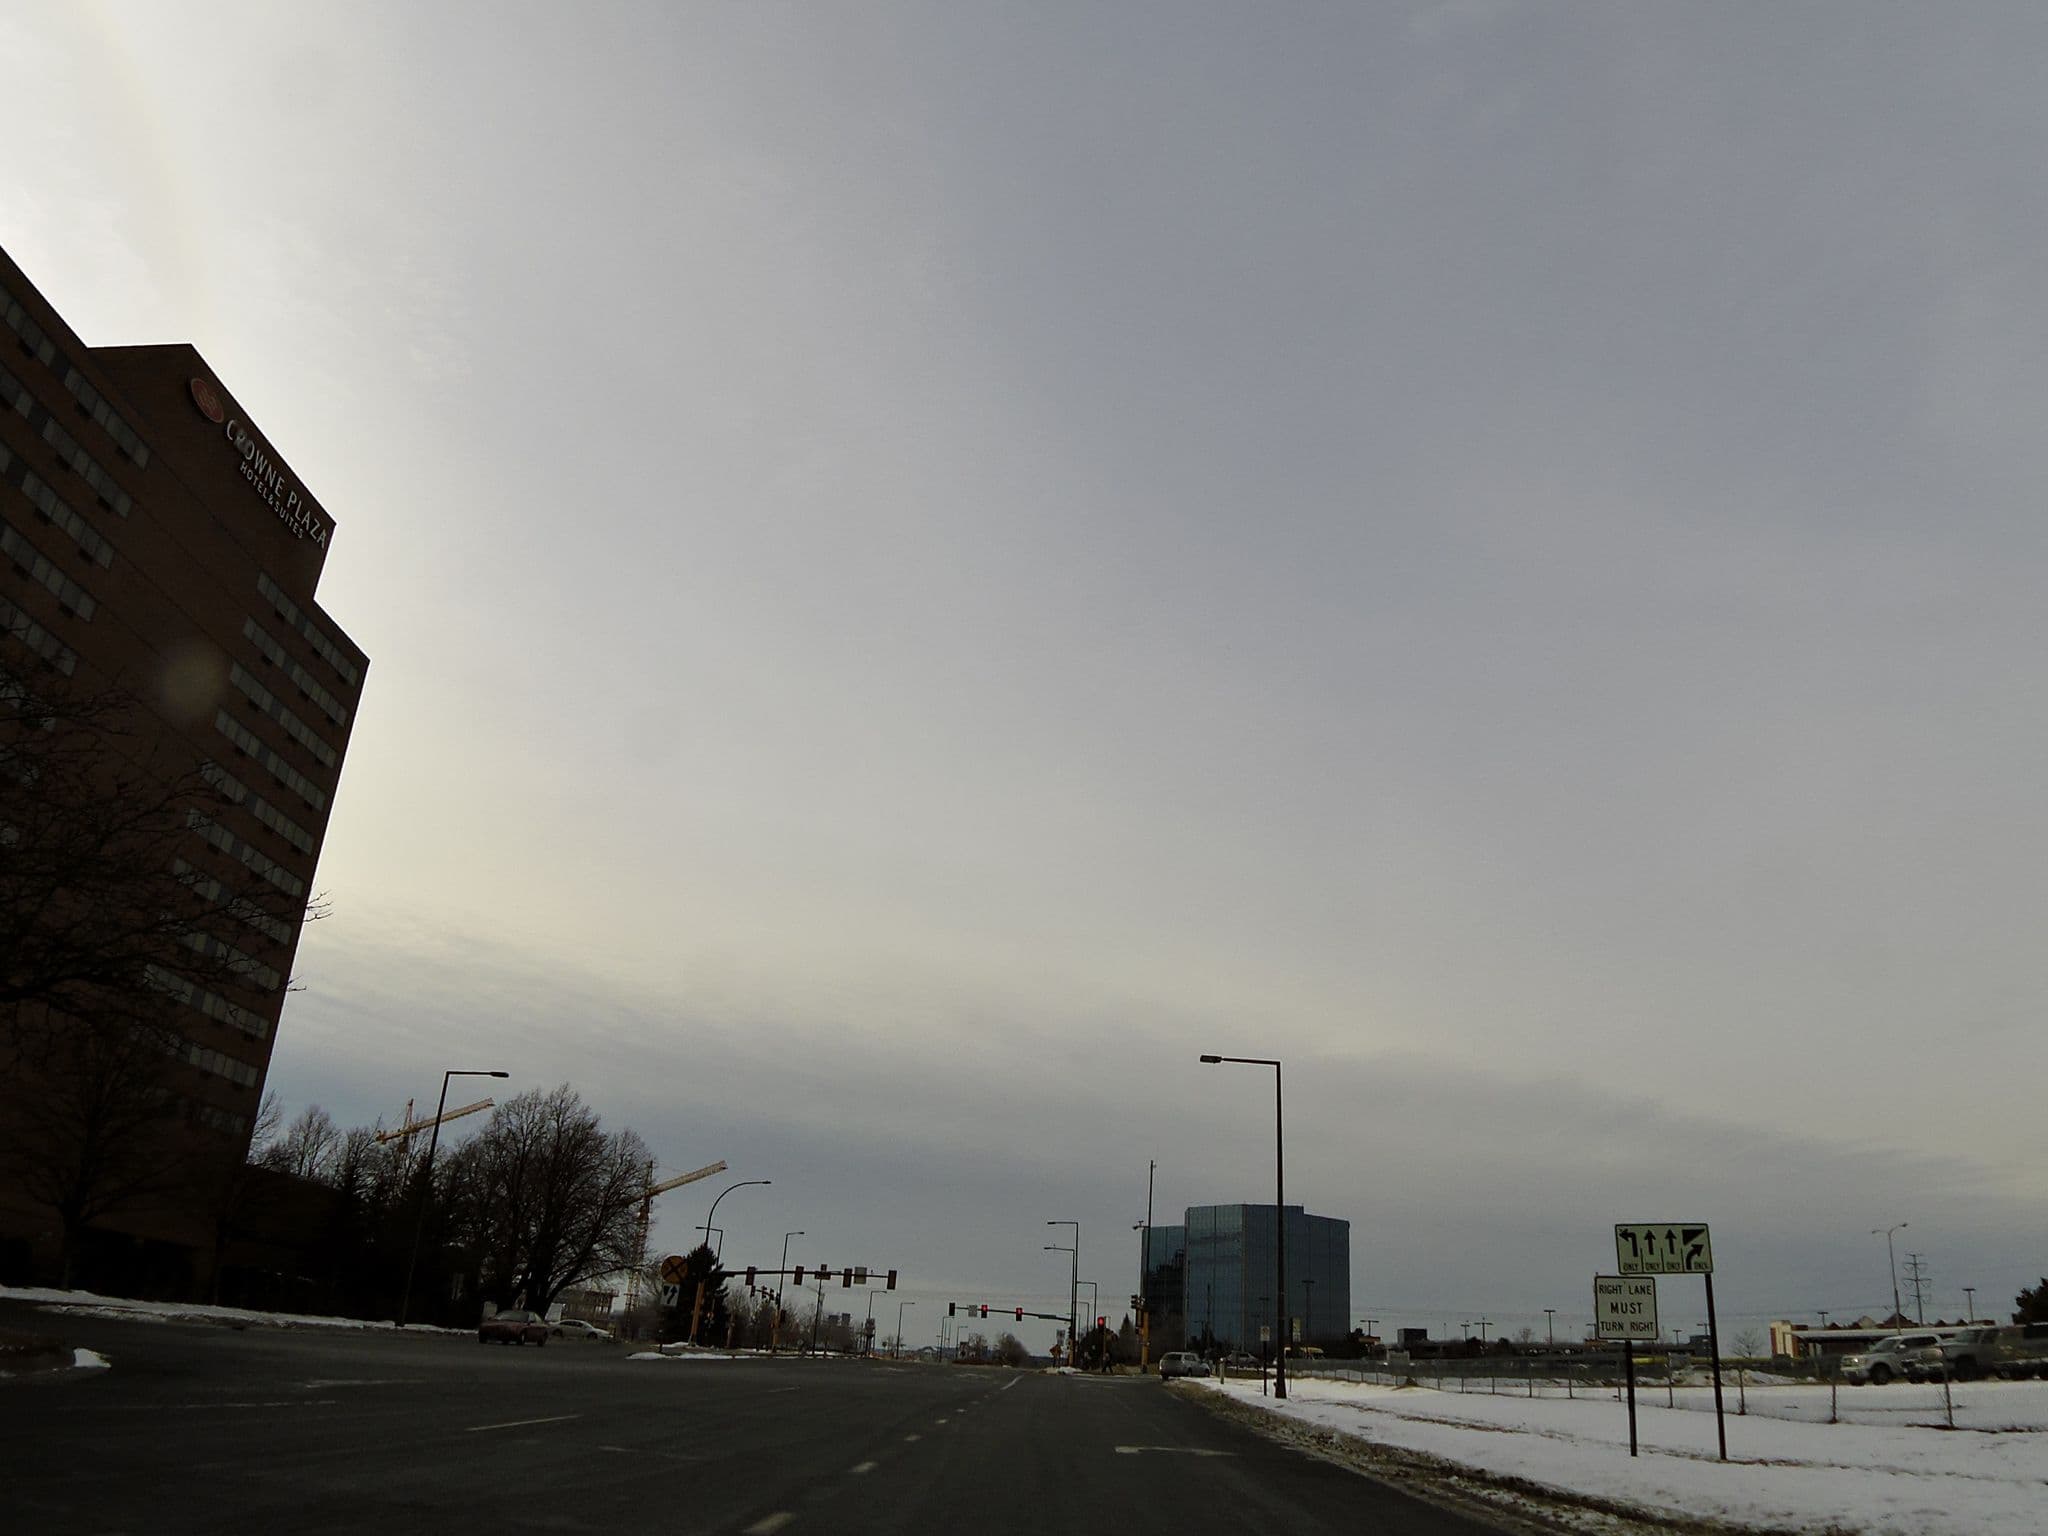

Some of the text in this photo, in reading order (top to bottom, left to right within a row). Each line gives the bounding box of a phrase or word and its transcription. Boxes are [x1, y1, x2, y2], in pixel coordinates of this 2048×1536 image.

[287, 490, 327, 549] PLAZA
[1623, 1263, 1638, 1271] ONLY
[1599, 1284, 1652, 1295] RIGHT LANE
[1610, 1302, 1642, 1314] MUST
[1600, 1321, 1654, 1332] TURN RIGHT
